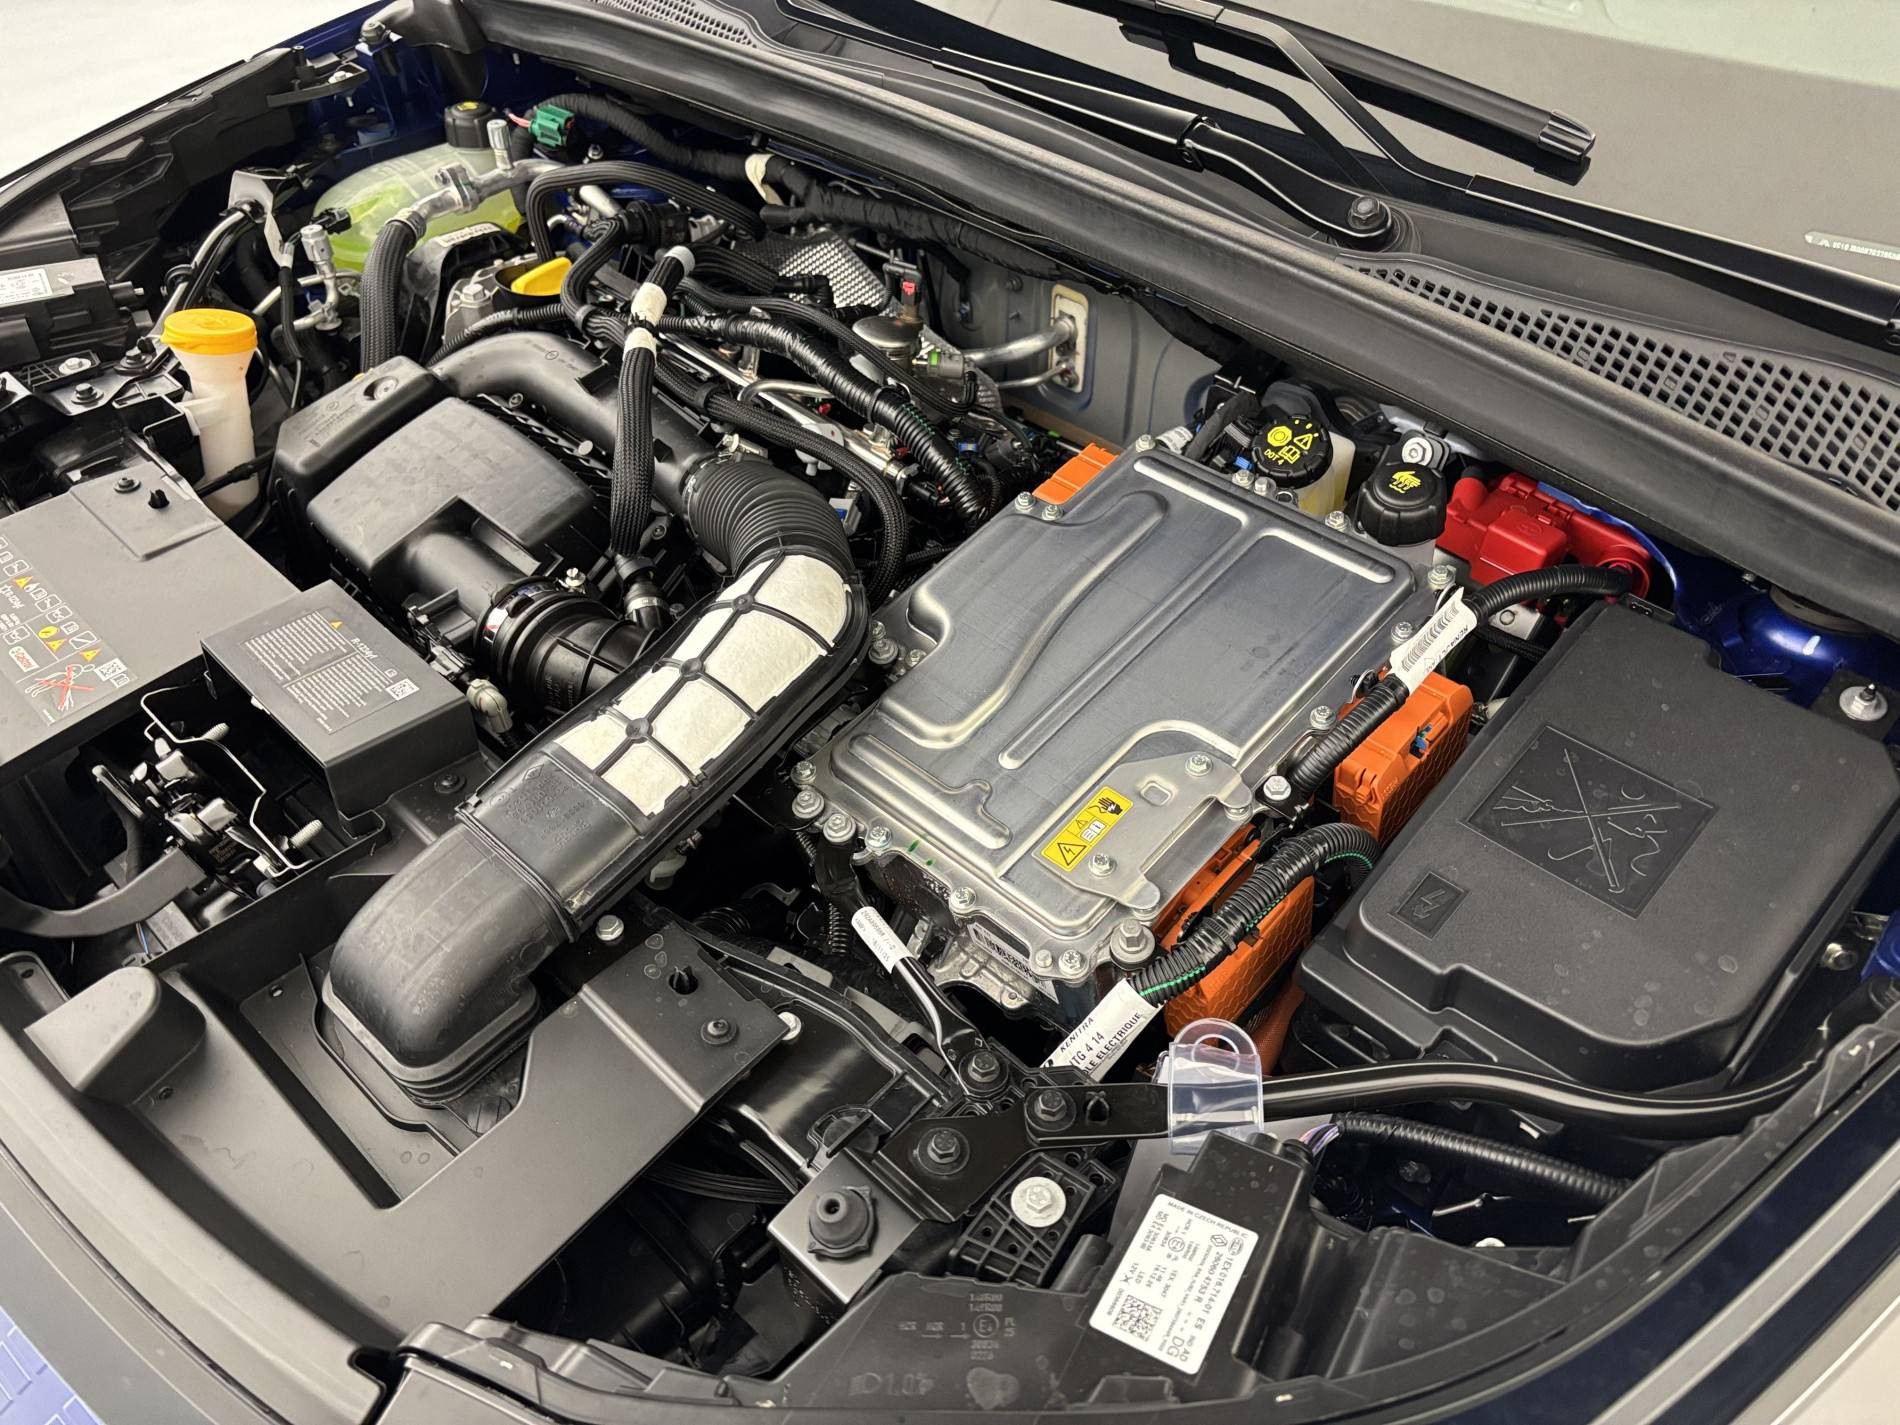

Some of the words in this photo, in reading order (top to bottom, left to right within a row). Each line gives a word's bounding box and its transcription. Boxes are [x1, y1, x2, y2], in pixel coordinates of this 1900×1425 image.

[1264, 449, 1278, 461] DOT
[1060, 1016, 1094, 1053] KENITRA
[1086, 1043, 1093, 1052] 4
[1092, 1031, 1105, 1046] 14
[1096, 1012, 1141, 1060] ELECTRIQUE
[1168, 1201, 1185, 1212] MADE
[1194, 1212, 1216, 1225] CZECH
[1217, 1222, 1248, 1239] REPUBLIC
[1129, 1262, 1139, 1274] 12V
[1135, 1271, 1146, 1284] LED
[1194, 1317, 1206, 1330] ES
[1166, 1335, 1185, 1358] DG
[1179, 1348, 1191, 1362] AD
